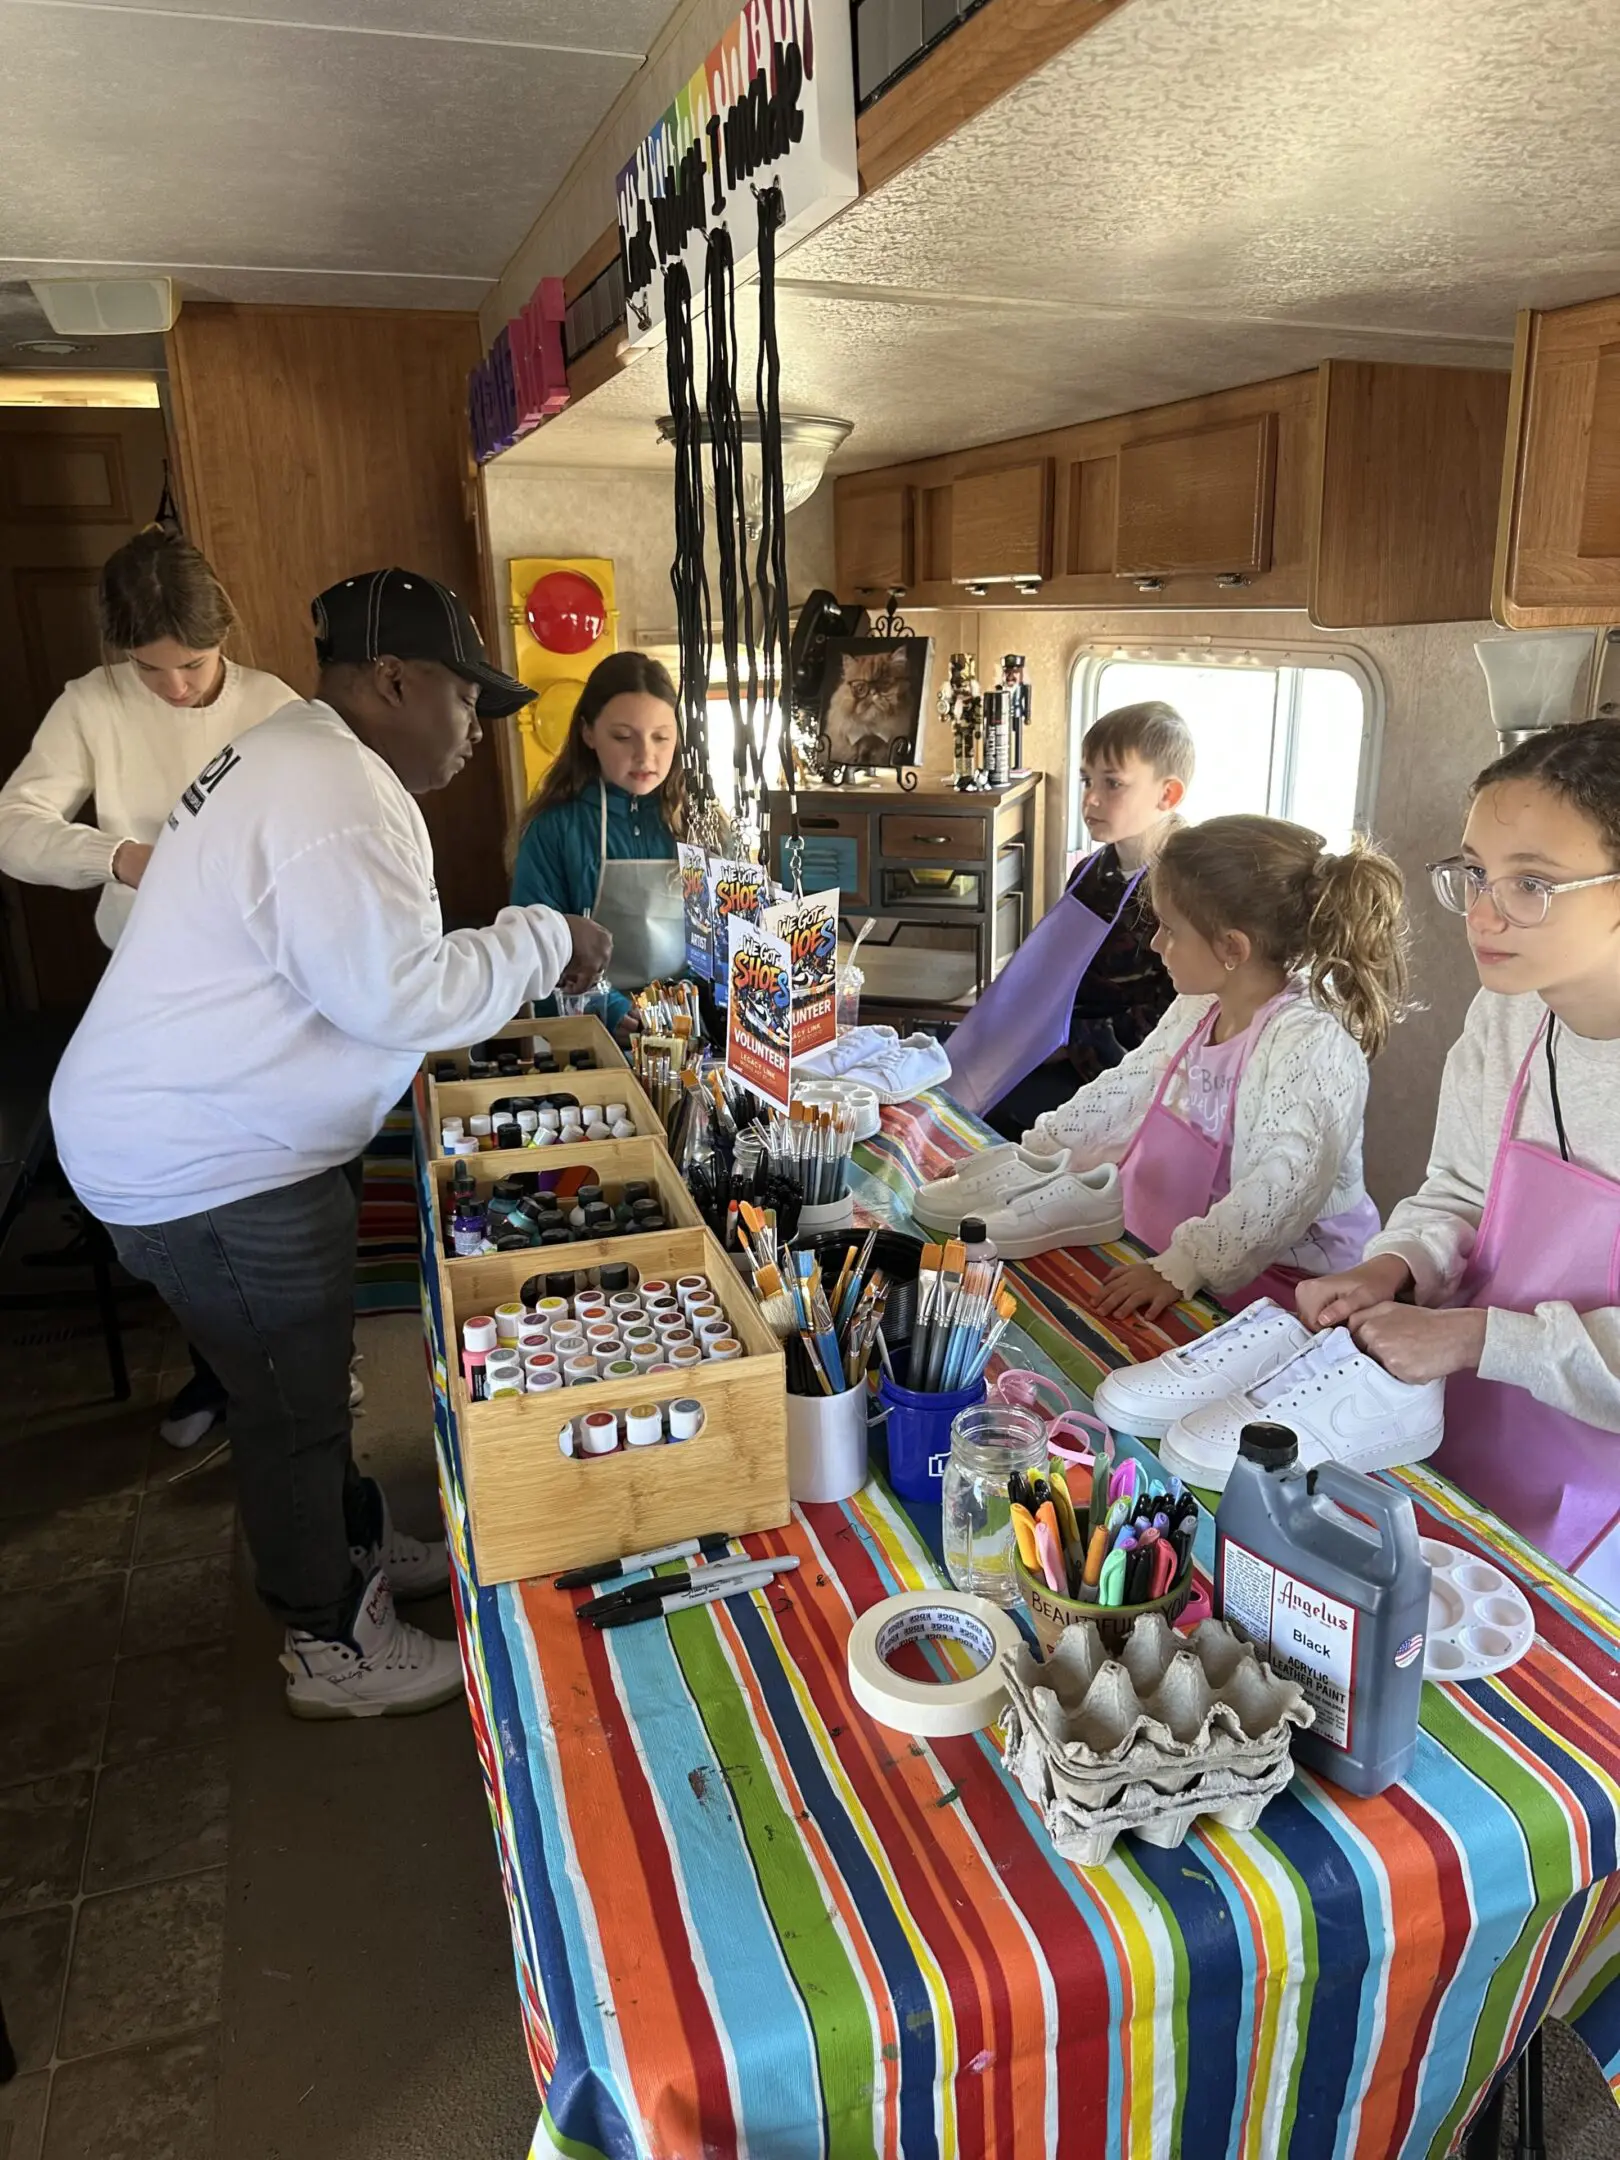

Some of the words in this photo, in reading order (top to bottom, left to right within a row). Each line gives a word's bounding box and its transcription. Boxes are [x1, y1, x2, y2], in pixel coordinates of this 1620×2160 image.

[777, 914, 799, 940] WE
[786, 915, 837, 965] HOES
[742, 934, 761, 957] WE
[760, 942, 782, 966] GOT
[733, 950, 791, 1009] SHOES
[792, 999, 832, 1027] UNTEER
[734, 1027, 787, 1073] VOLUNTEER
[1277, 1581, 1349, 1631] Angelus
[1293, 1628, 1331, 1659] Black
[1272, 1656, 1313, 1689] LEATHER
[1315, 1681, 1346, 1704] PAINT
[1288, 1656, 1329, 1685] ACRYLIC
